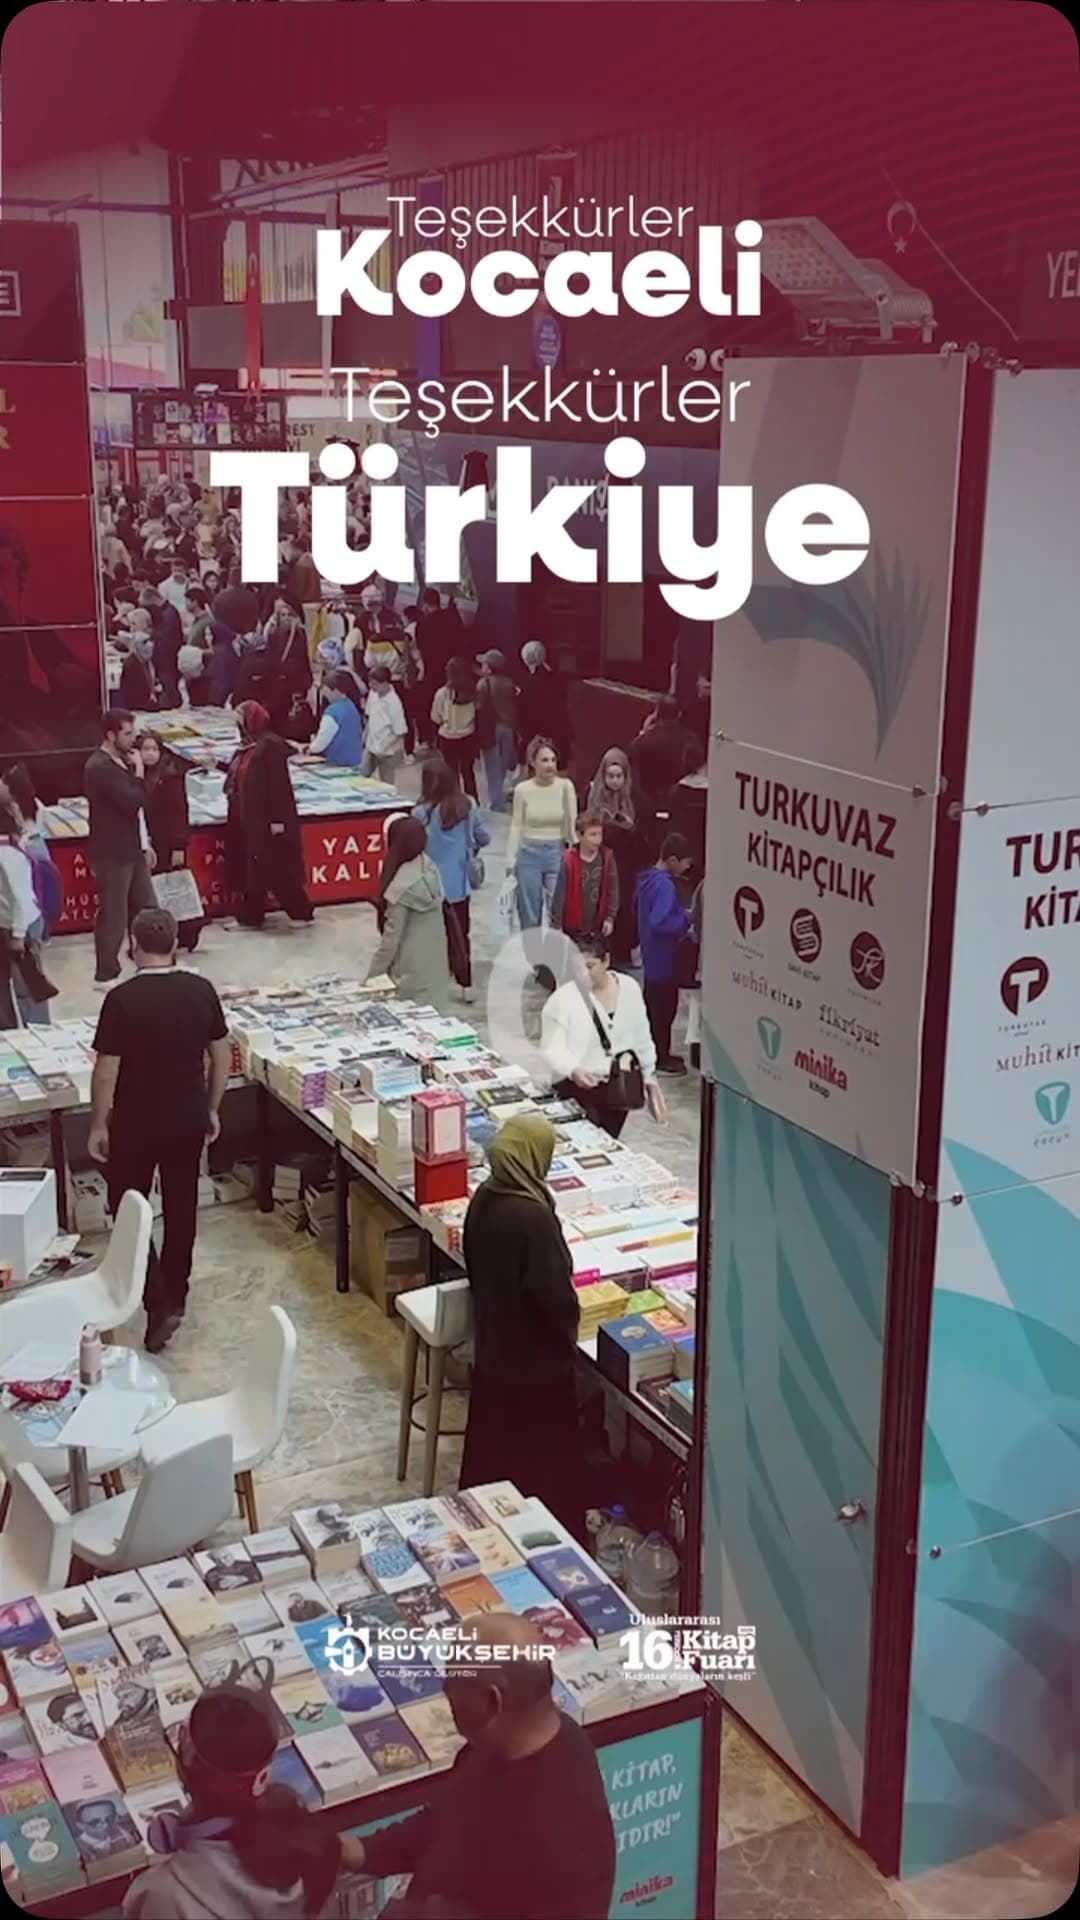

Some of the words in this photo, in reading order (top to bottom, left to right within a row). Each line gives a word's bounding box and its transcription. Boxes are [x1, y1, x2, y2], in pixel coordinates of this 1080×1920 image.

[735, 771, 897, 858] TURKUVAZ
[748, 830, 875, 907] KİTAPÇILIK
[794, 1048, 848, 1092] minika
